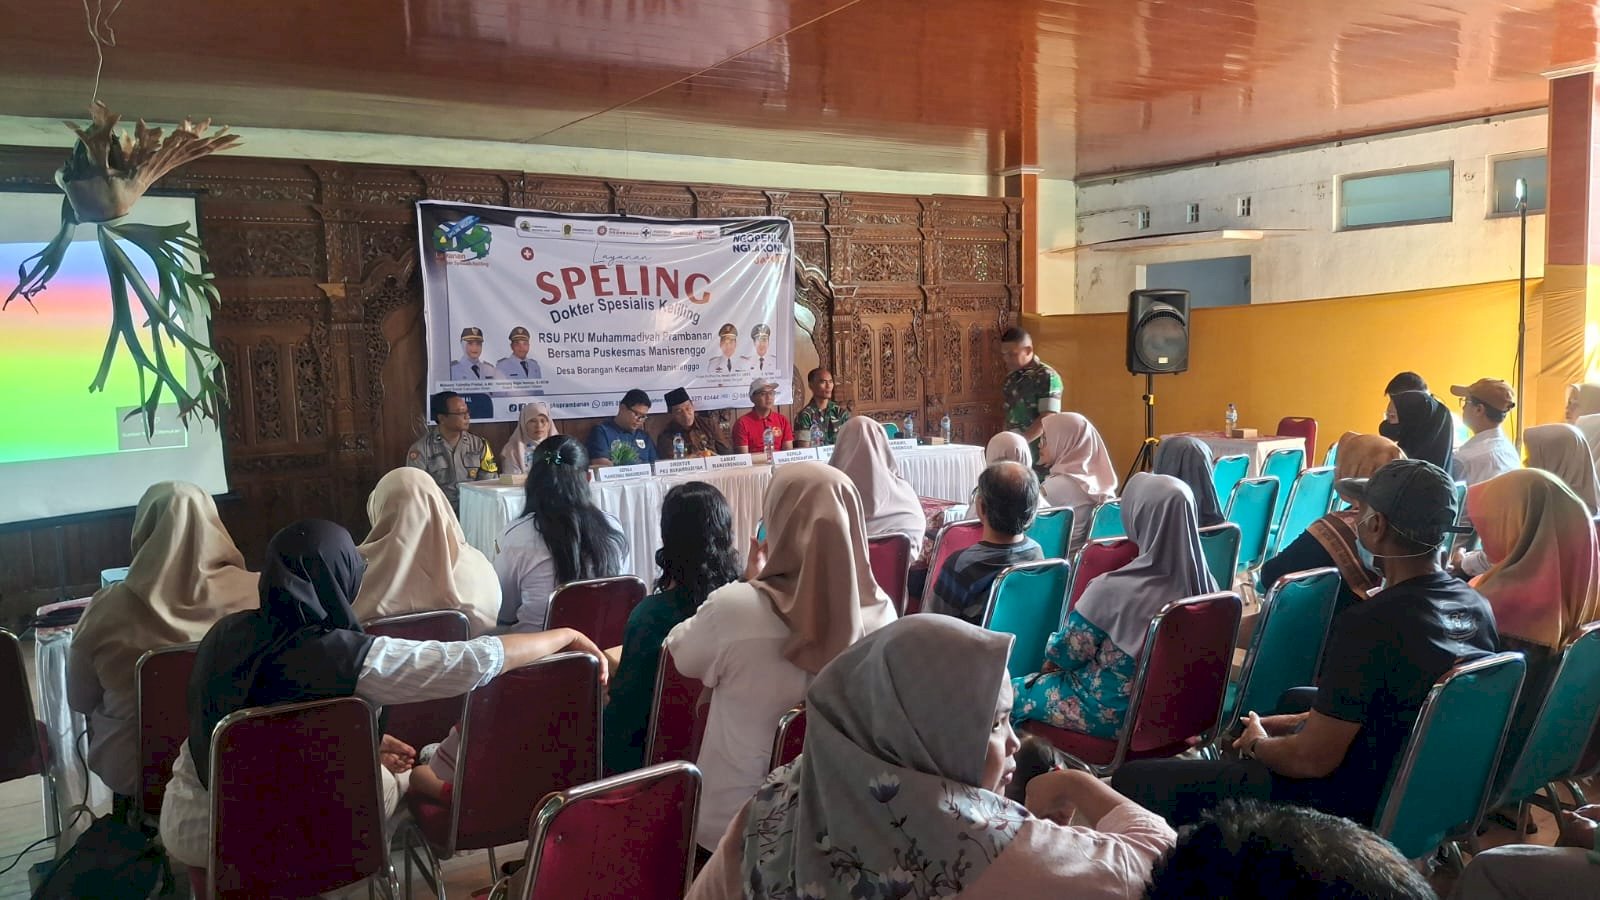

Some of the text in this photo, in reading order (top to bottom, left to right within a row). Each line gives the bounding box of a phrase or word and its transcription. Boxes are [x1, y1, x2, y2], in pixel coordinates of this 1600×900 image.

[535, 264, 712, 305] SPELING
[549, 297, 701, 325] Dokter Spesialis Keliling
[539, 331, 713, 345] RSU PKU Muhammadiyah Prambanan
[548, 346, 706, 359] Bersama Puskesmas Manisrenggo
[556, 366, 576, 375] Desa
[577, 365, 613, 376] Borangan
[615, 364, 655, 374] Kecamatan
